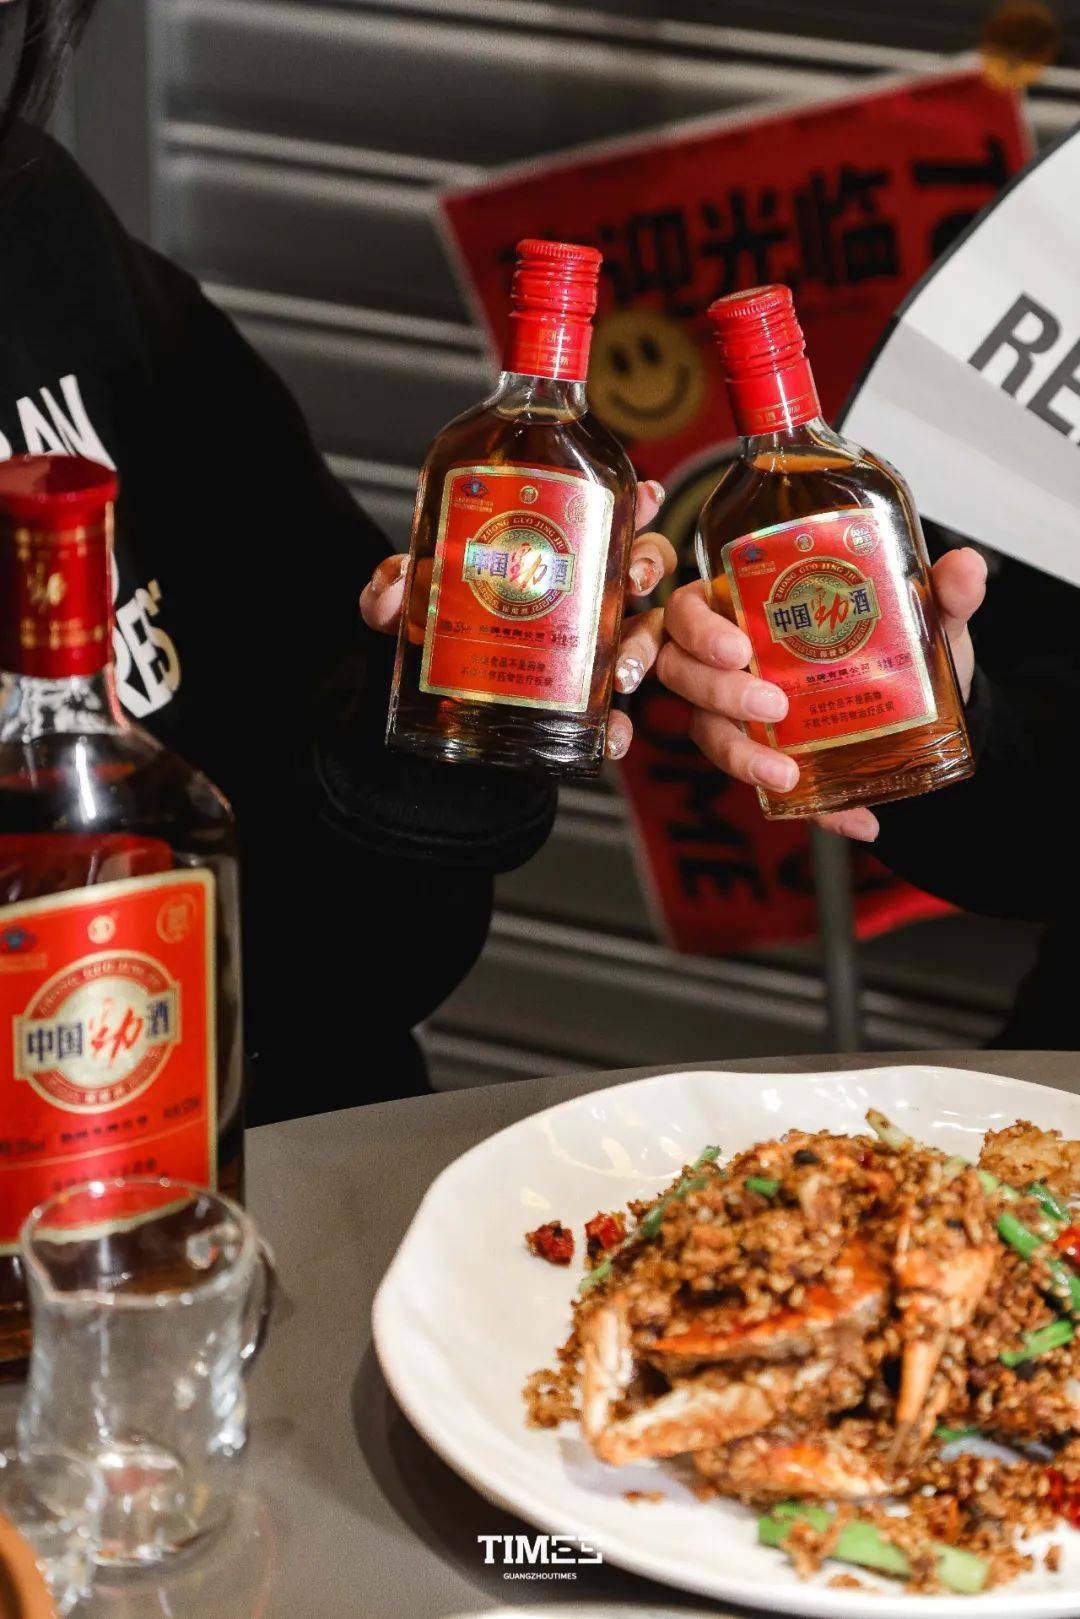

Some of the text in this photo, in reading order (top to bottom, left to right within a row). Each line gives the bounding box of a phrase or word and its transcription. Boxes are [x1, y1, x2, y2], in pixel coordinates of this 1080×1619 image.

[496, 160, 900, 316] 迎光临
[967, 290, 1080, 450] RE
[0, 373, 117, 471] AN
[773, 585, 872, 636] 中国劲酒
[26, 996, 171, 1068] 中国劲酒
